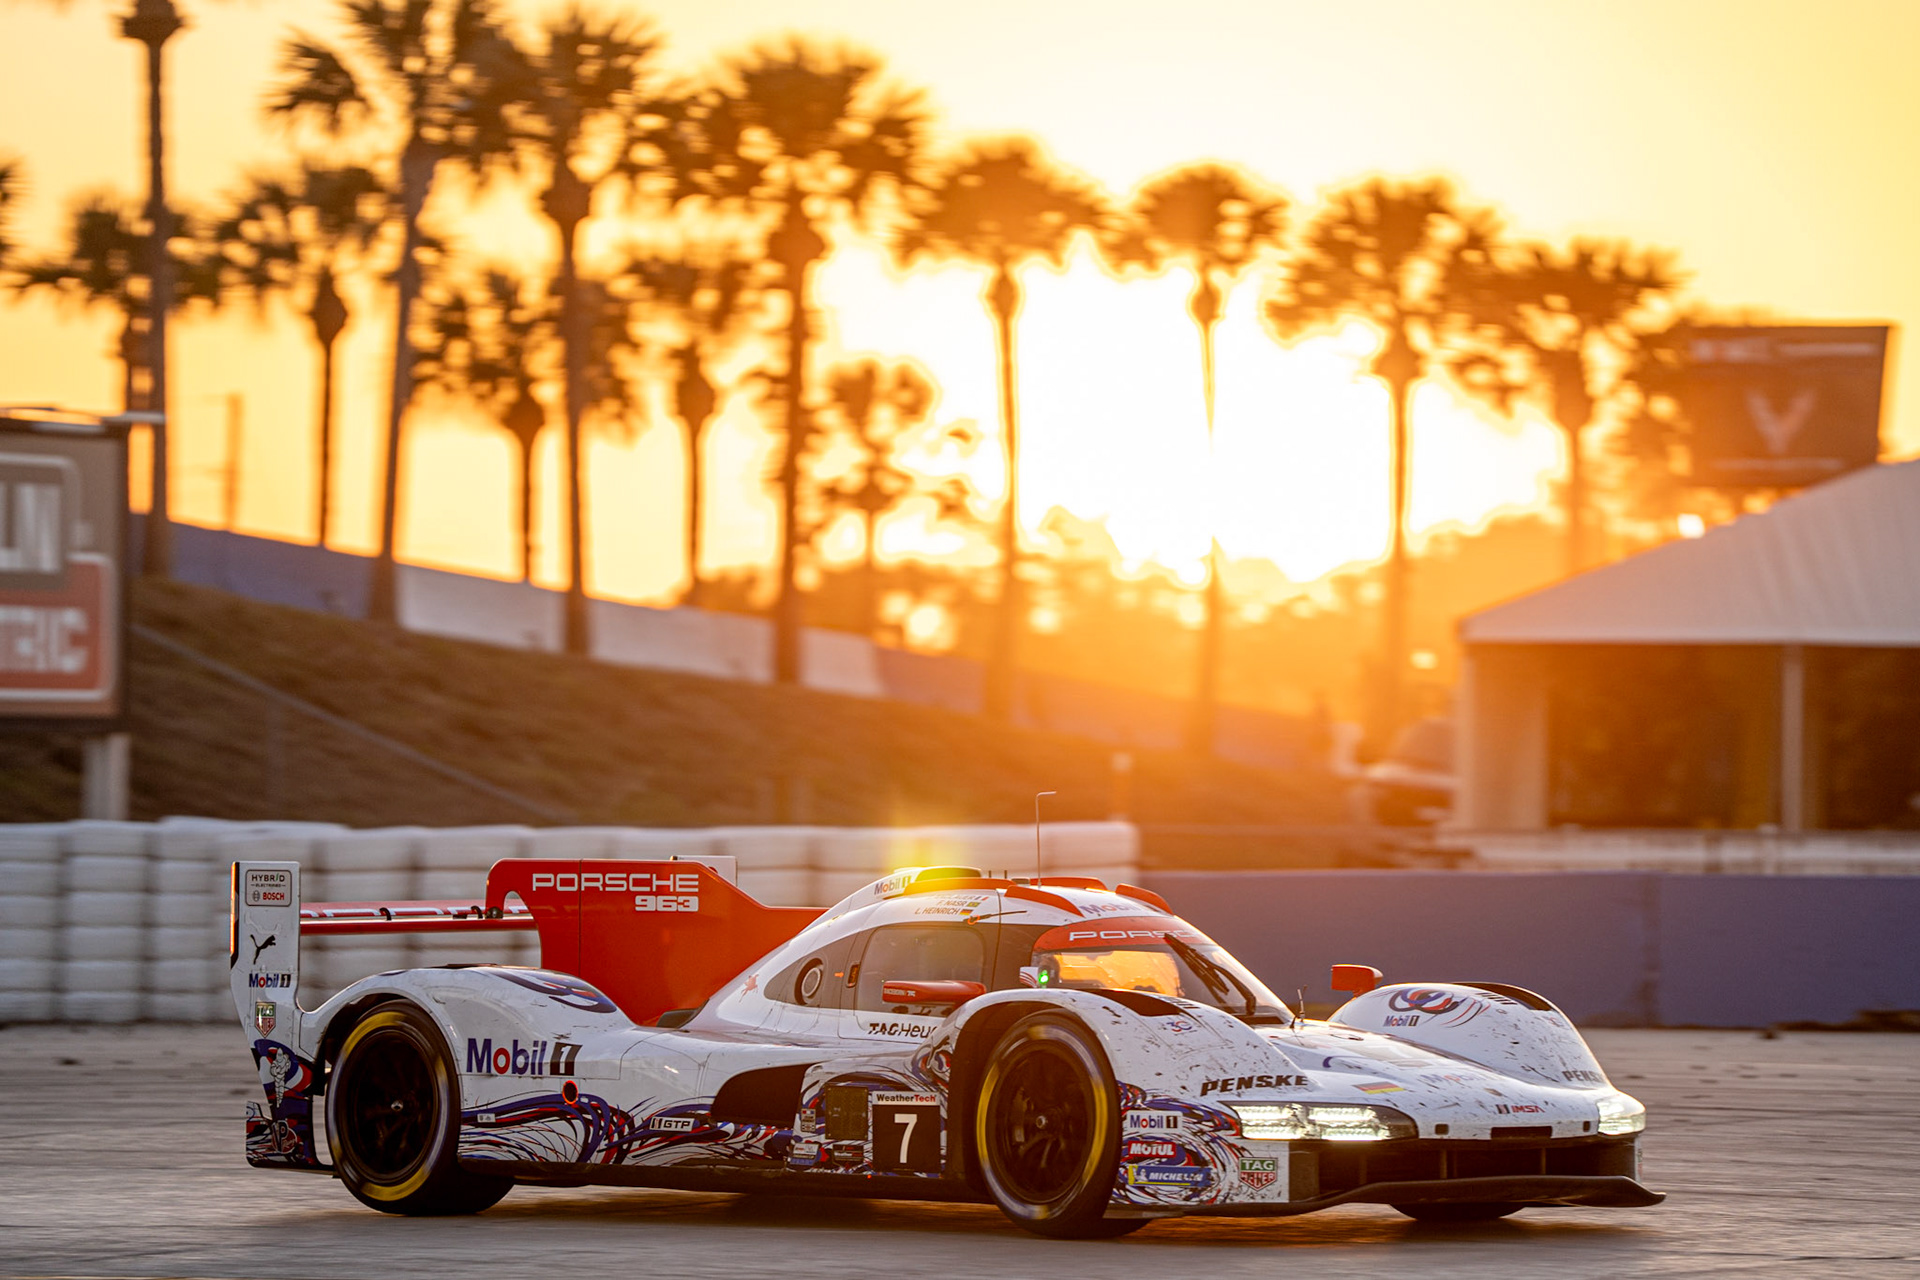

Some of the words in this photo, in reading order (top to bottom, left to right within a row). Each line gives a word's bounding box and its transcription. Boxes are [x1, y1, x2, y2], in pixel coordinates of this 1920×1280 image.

[251, 872, 286, 882] HYBRID
[532, 873, 699, 892] PORSCHE
[873, 877, 900, 896] Mobil
[262, 892, 285, 901] BOSCH
[635, 895, 699, 912] 963
[921, 907, 961, 915] HEINRICH
[248, 973, 280, 988] Mobil
[1382, 1015, 1410, 1028] Mobil
[466, 1037, 548, 1075] Mobil
[1200, 1074, 1310, 1096] PENSKE
[876, 1094, 937, 1103] WeatherTech
[1511, 1105, 1546, 1113] IMSA
[663, 1120, 691, 1129] GTP
[1130, 1115, 1164, 1129] Mobil
[894, 1113, 917, 1164] 7
[1130, 1143, 1175, 1156] MOTUL
[1242, 1160, 1274, 1170] TAG
[1148, 1172, 1205, 1182] MICHELIN
